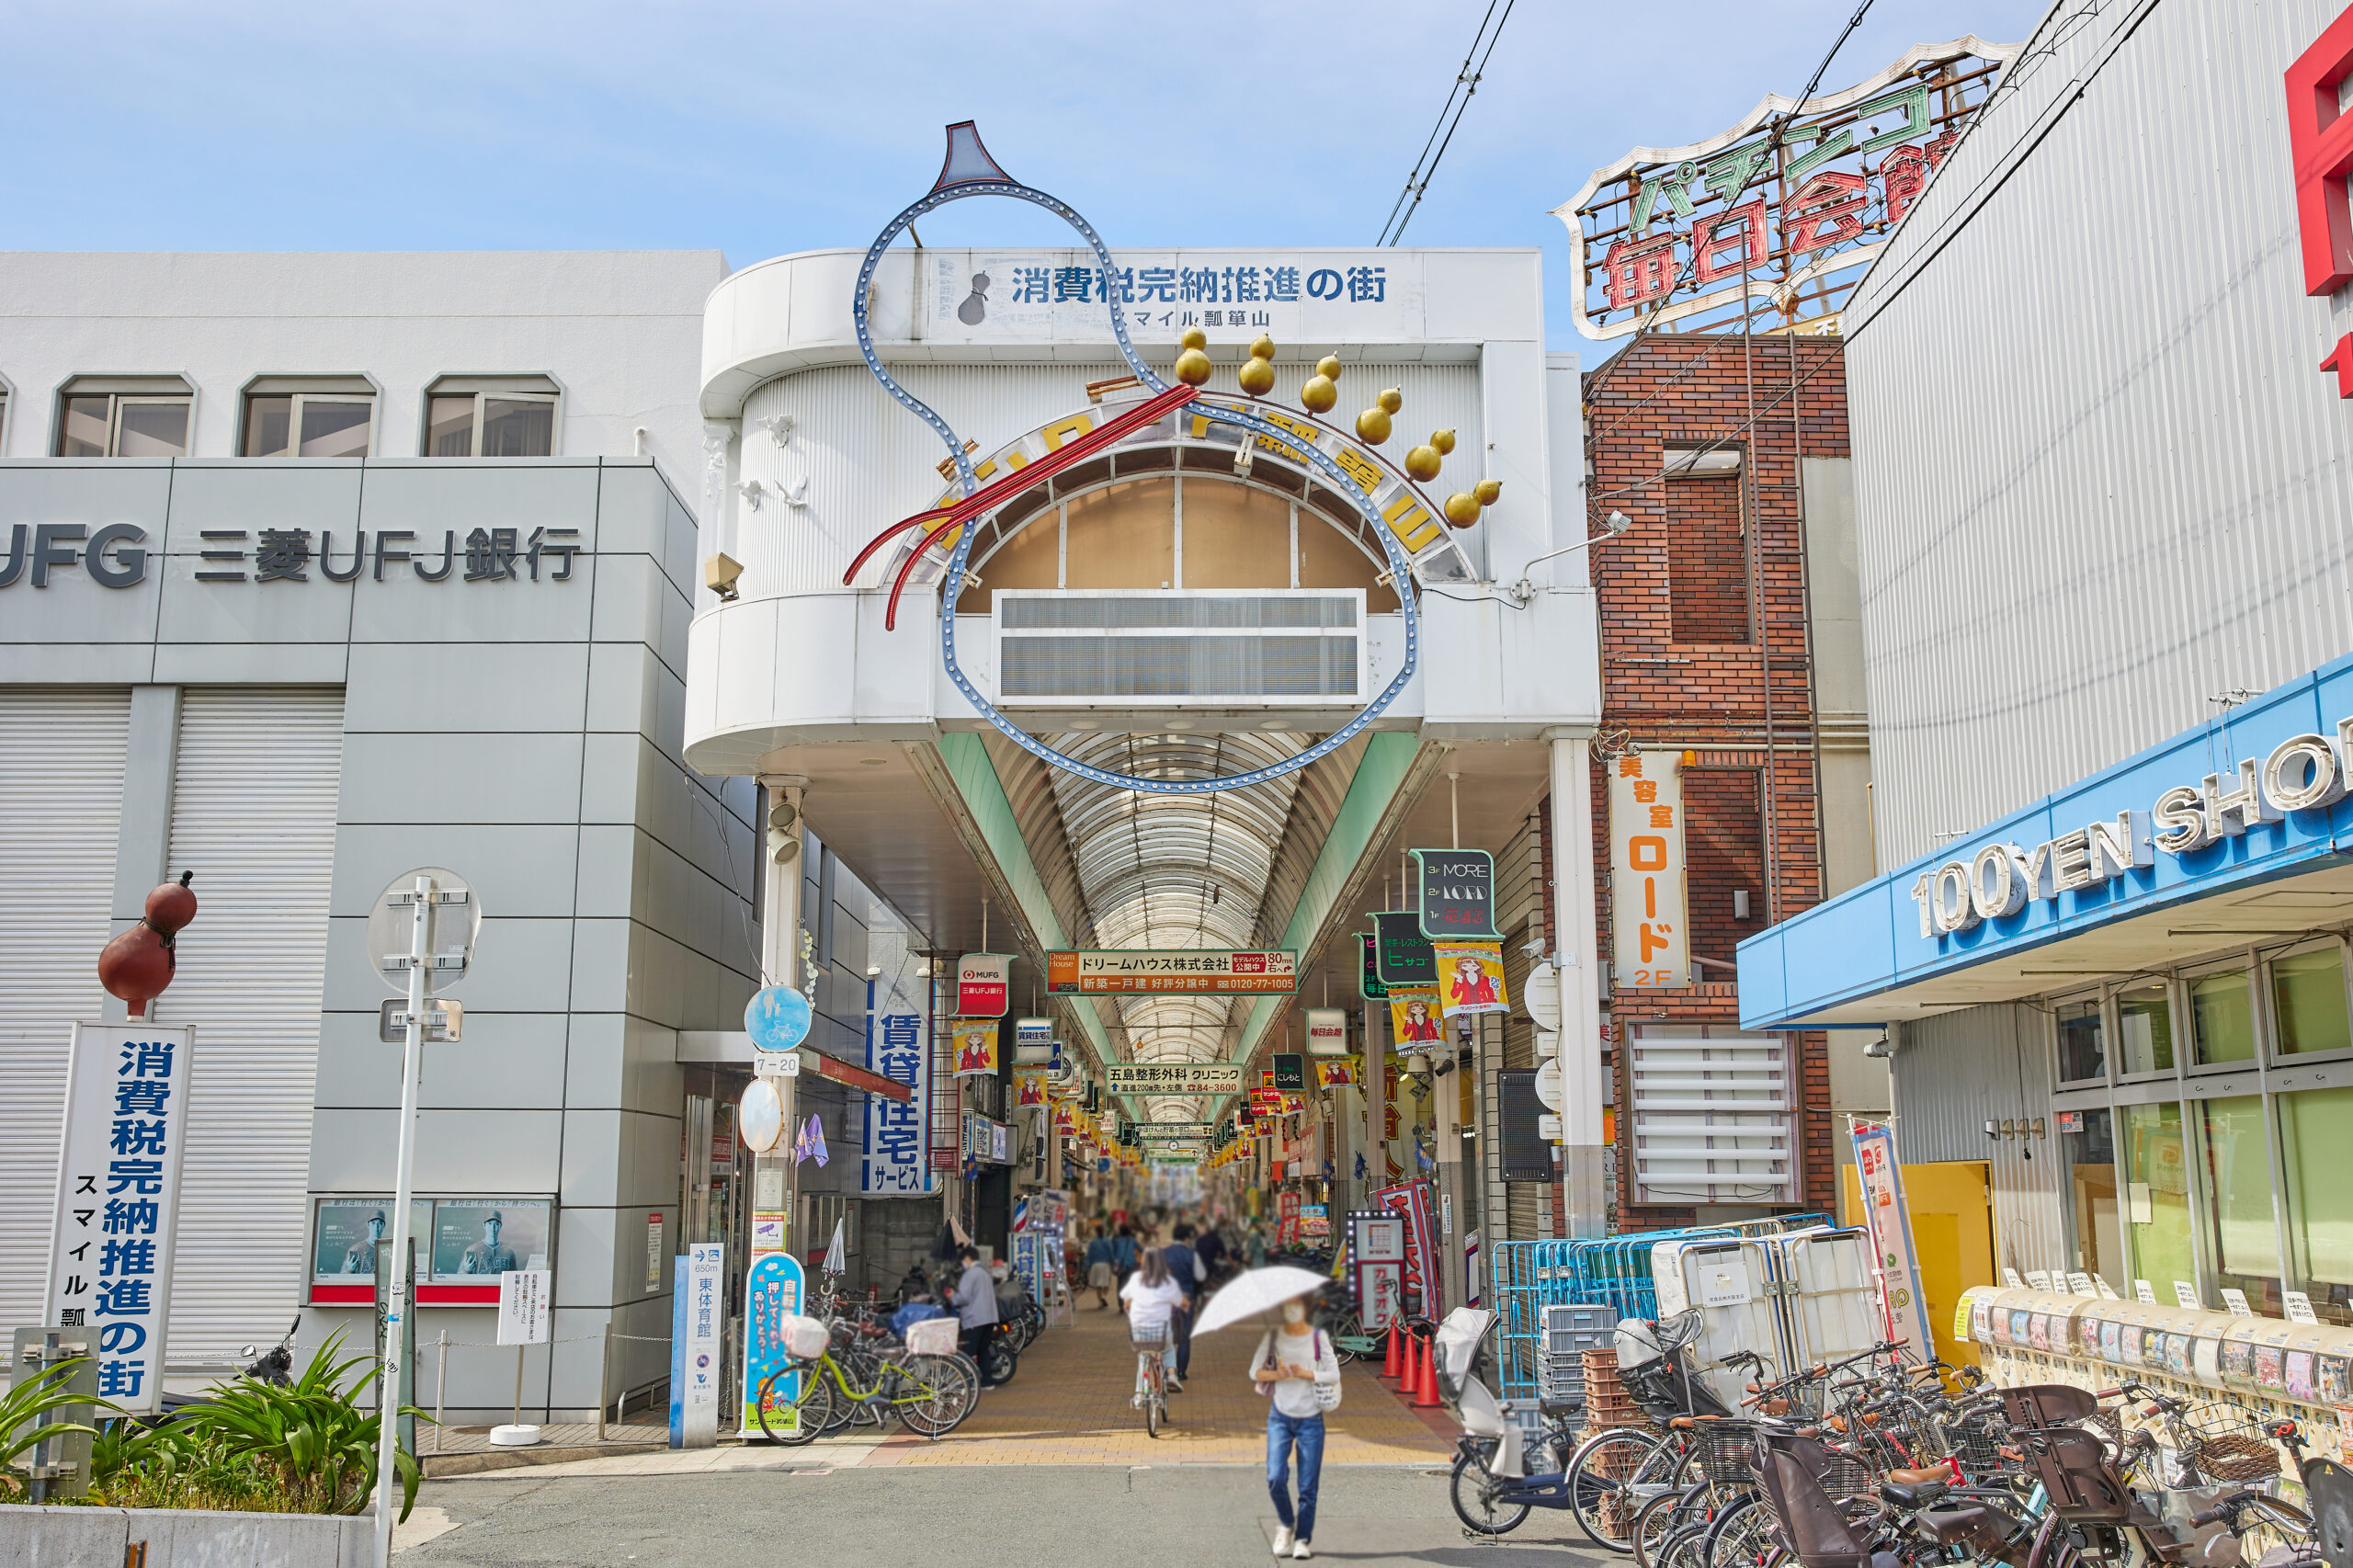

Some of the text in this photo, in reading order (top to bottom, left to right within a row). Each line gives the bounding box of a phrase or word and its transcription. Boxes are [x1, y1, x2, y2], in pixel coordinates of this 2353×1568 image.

[1628, 83, 1931, 234] パチンコ
[1012, 266, 1386, 303] 消費税完納推進の街
[194, 526, 581, 583] 三菱UFJ銀行
[1619, 755, 1674, 828] 美容室
[2154, 715, 2353, 854] SHO
[1427, 863, 1489, 878] 3F MORE
[1427, 884, 1488, 901] 2F LORD
[1629, 835, 1673, 964] ロード
[1429, 911, 1439, 919] 1F
[1082, 957, 1230, 971] ドリームハウス株式会社
[1235, 963, 1260, 971] 公開中
[1083, 978, 1294, 990] 新築一戸建 好評分譲中 0120-77-1005
[1634, 970, 1672, 986] 2F
[1311, 1028, 1343, 1038] 毎日会館
[1109, 1068, 1239, 1082] 五島整形外科 クリニック
[1277, 1074, 1301, 1082] にしもと
[877, 1013, 922, 1165] 賃貸住宅
[1197, 1083, 1237, 1092] 84-3600
[875, 1165, 920, 1191] サービス
[95, 1040, 176, 1398] 消費税完納推進の街
[695, 1264, 718, 1273] 650m
[1375, 1267, 1388, 1324] カラオケ
[697, 1277, 712, 1339] 東体育館
